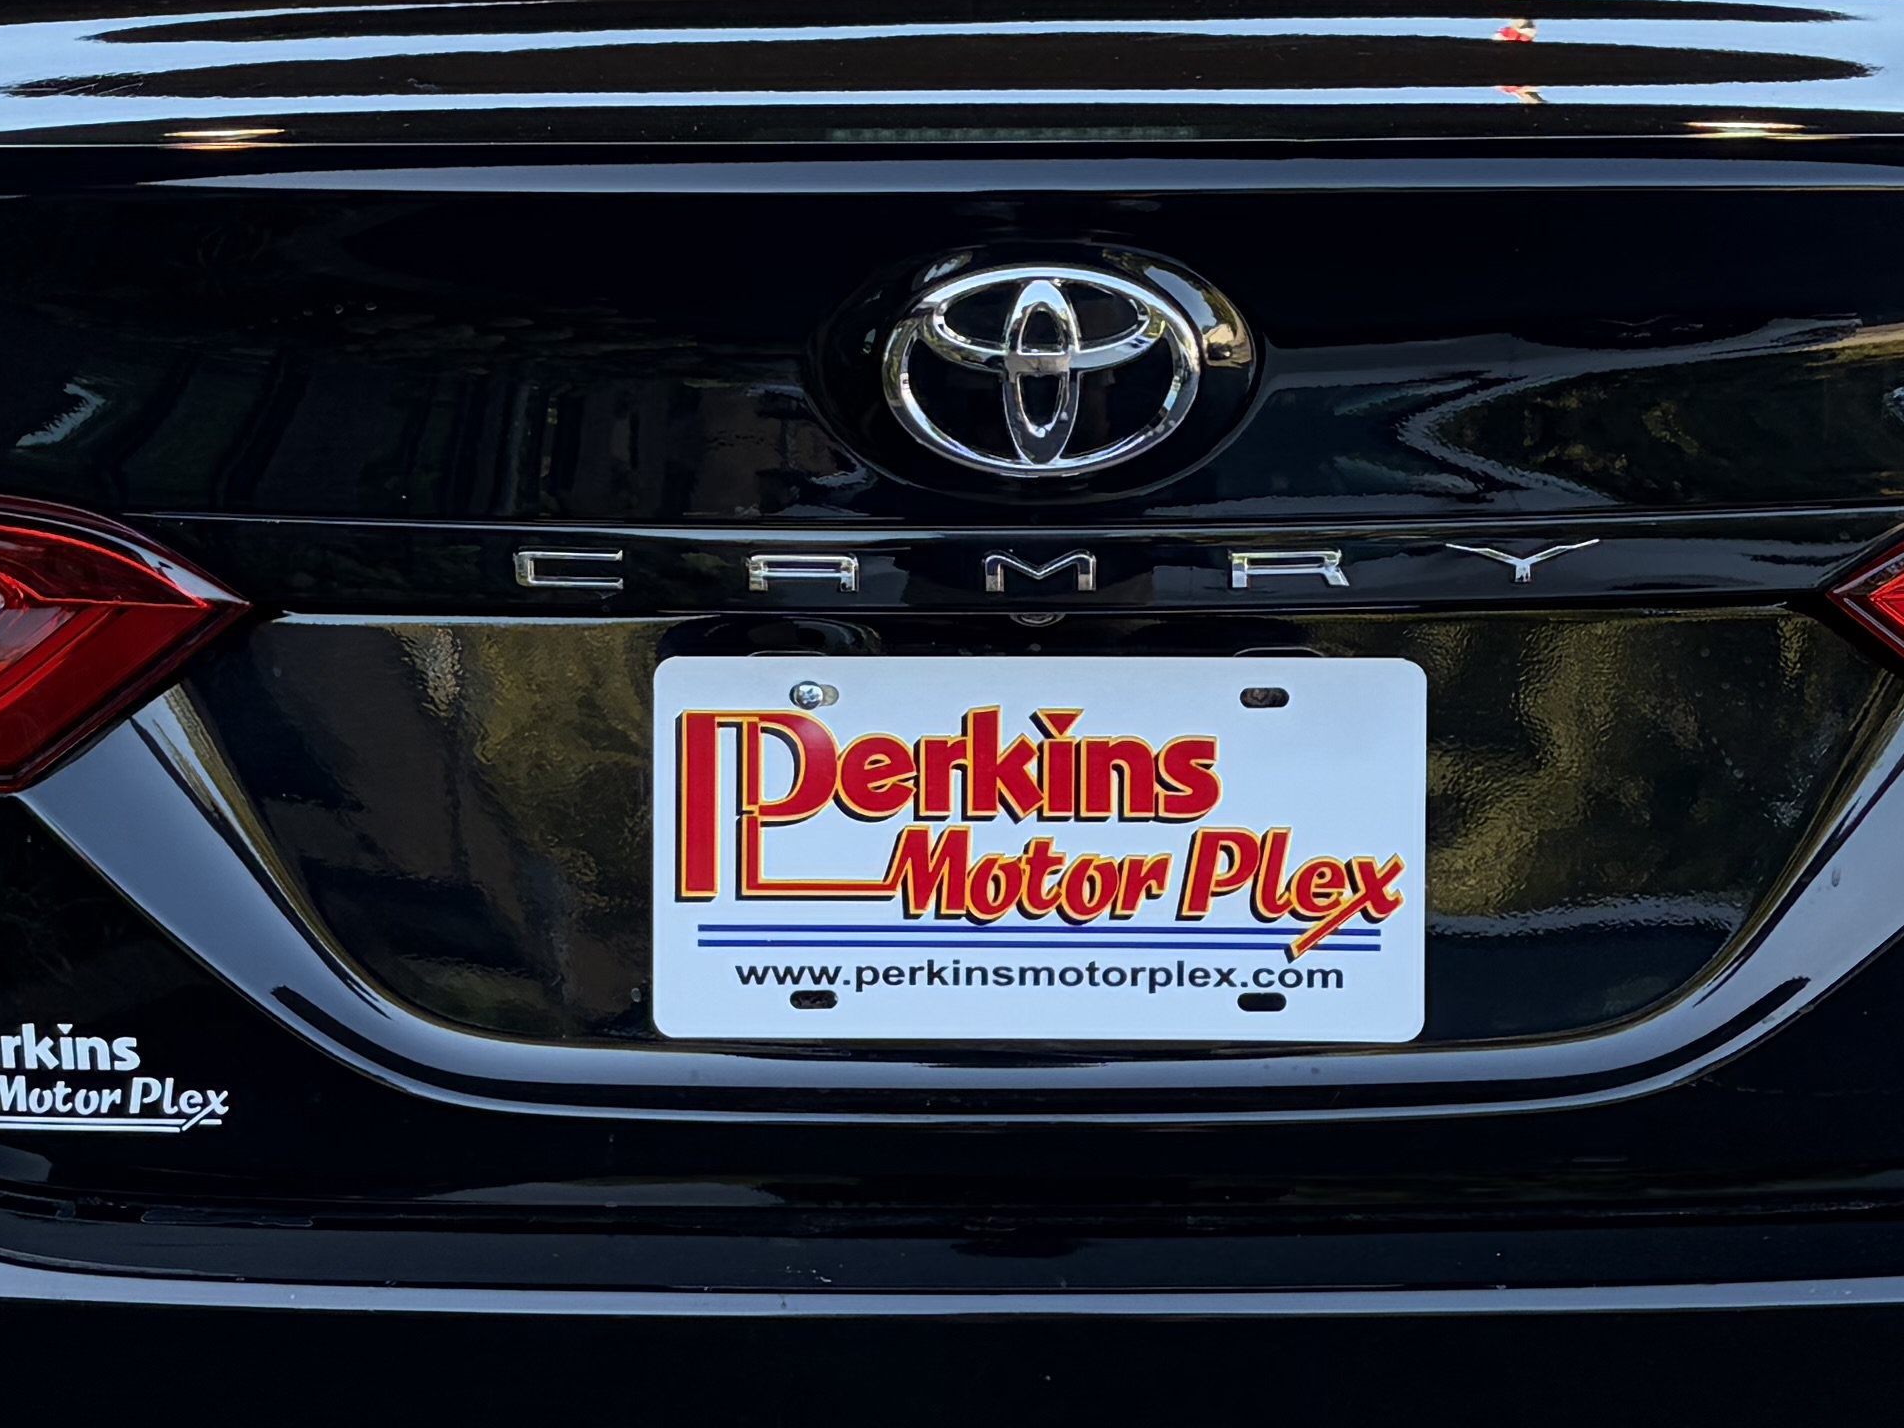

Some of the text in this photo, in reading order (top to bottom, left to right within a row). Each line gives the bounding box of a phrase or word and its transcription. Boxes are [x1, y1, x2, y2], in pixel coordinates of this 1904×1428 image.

[514, 538, 1601, 592] CAMRY
[674, 706, 1223, 903] Perkins
[885, 825, 1404, 960] Motor Plex
[736, 958, 1345, 992] www.perkinsmotorplex.com
[128, 1076, 230, 1131] Plex
